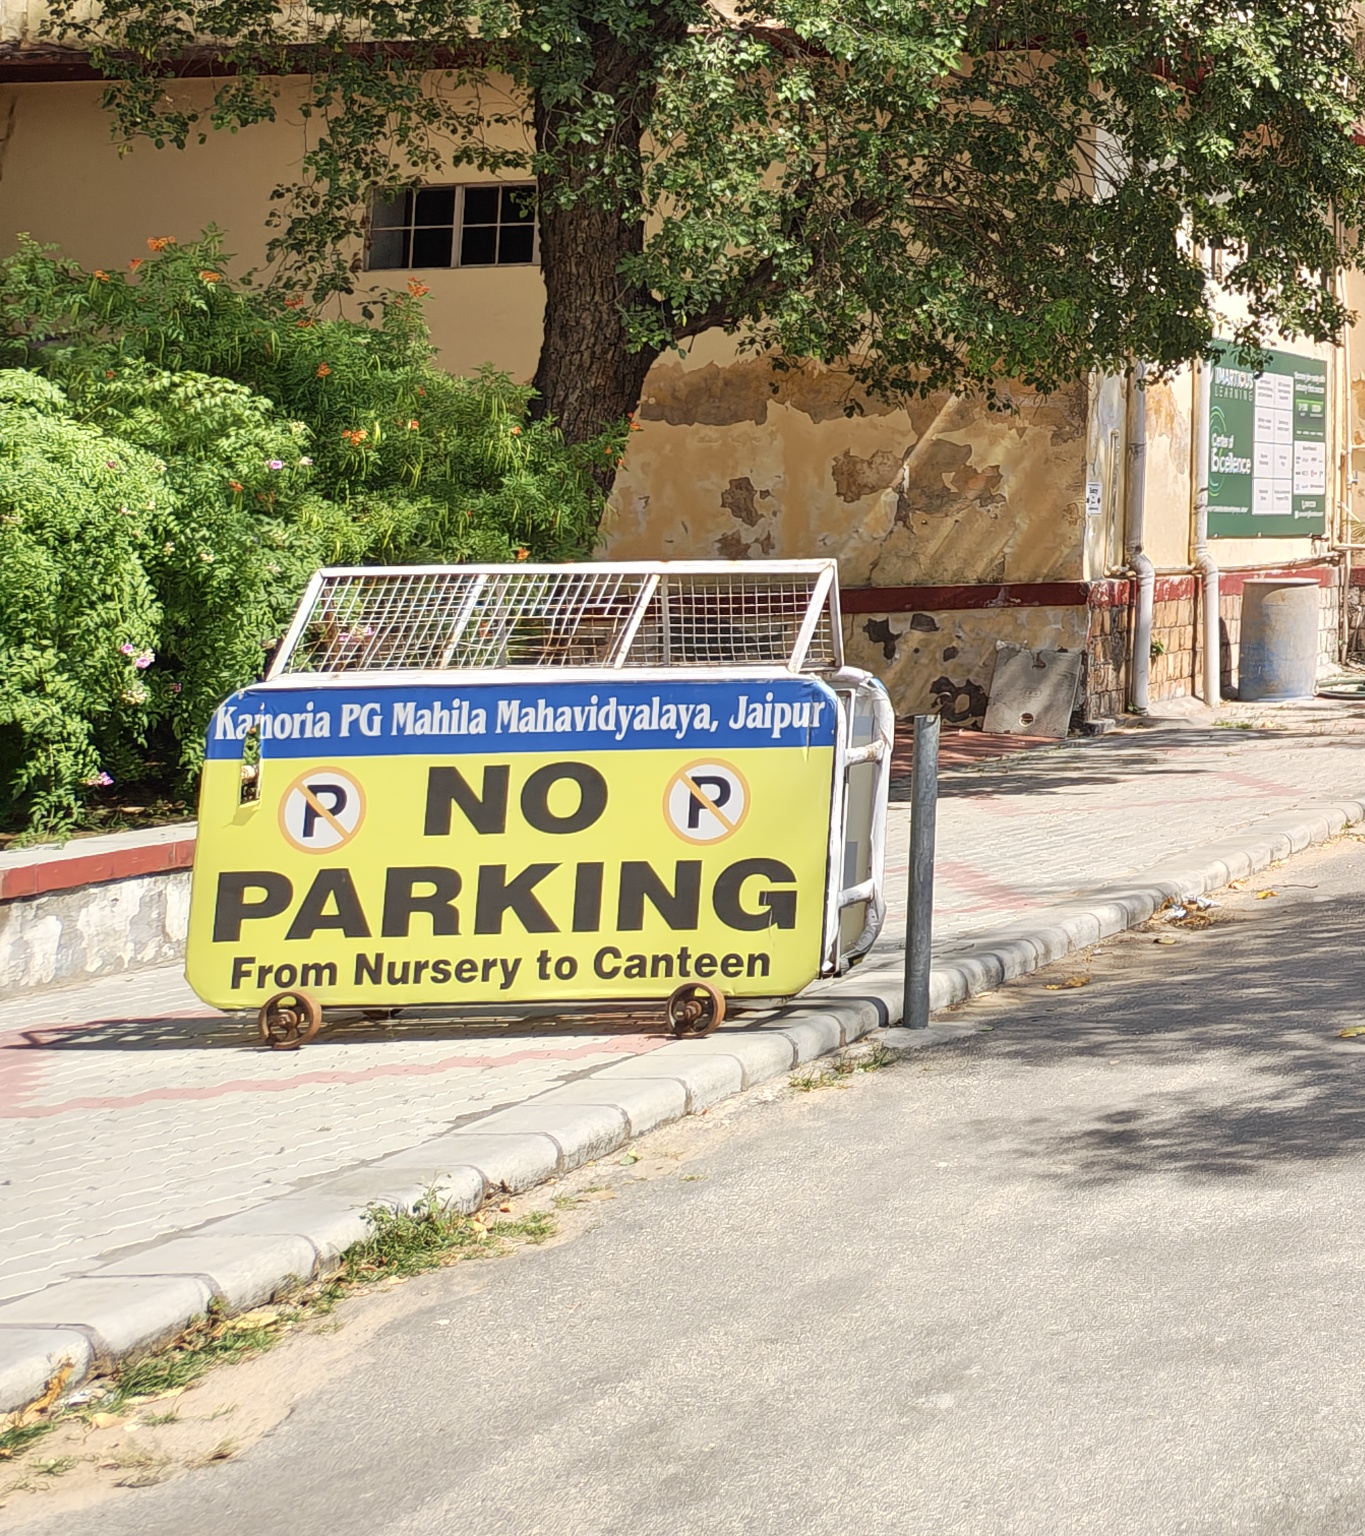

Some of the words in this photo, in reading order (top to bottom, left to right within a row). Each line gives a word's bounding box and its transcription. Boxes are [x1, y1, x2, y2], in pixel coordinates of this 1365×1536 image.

[339, 702, 383, 738] PG
[391, 698, 487, 736] Mahila
[495, 694, 719, 741] Mahavidyalaya,
[729, 692, 825, 739] Jaipur
[423, 761, 608, 836] NO
[212, 858, 797, 942] PARKING
[230, 956, 337, 989] From
[353, 953, 522, 990] Nursery
[537, 950, 578, 980] to
[593, 946, 770, 980] Canteen
